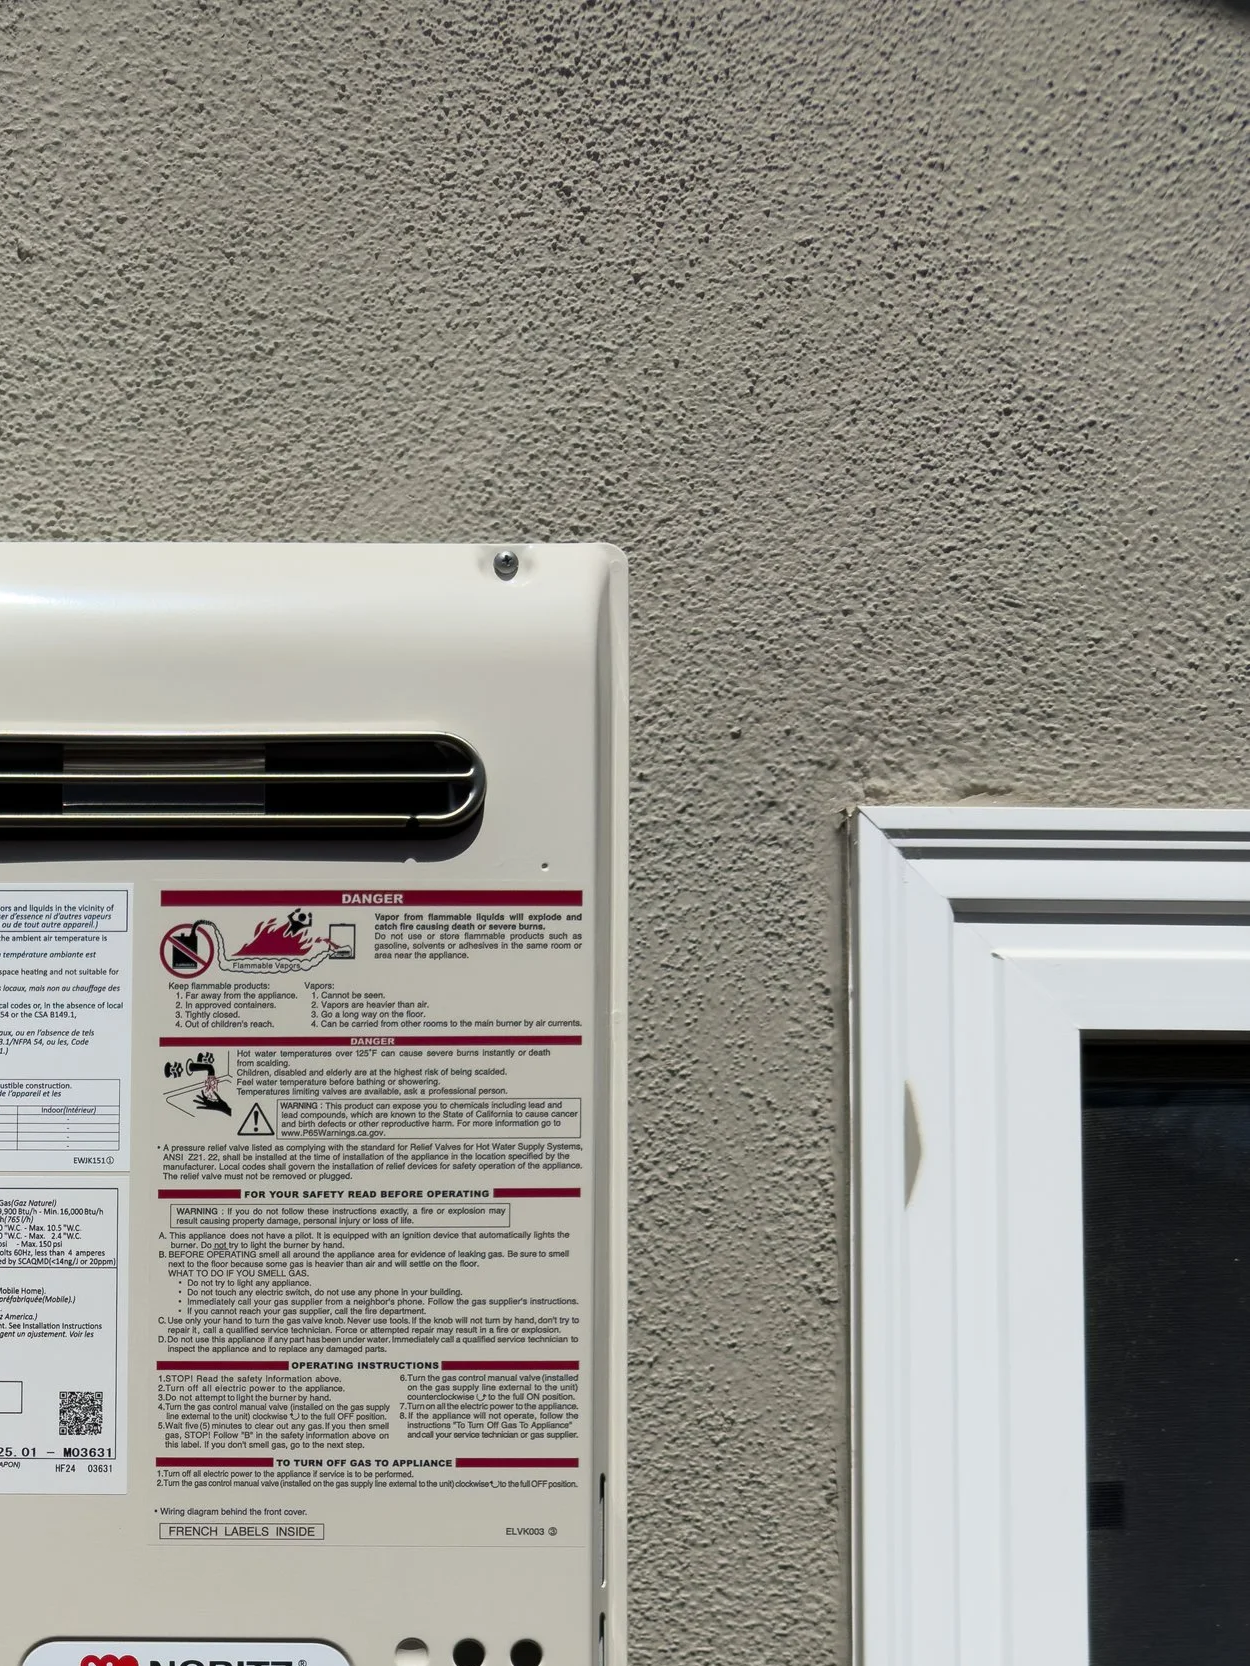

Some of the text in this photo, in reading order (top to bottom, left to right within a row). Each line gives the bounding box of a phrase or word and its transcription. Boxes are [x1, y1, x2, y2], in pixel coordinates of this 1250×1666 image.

[341, 893, 403, 903] DANGER
[374, 913, 399, 922] Vapor
[403, 912, 423, 920] from
[476, 912, 504, 922] liquids
[528, 913, 561, 922] explode
[168, 981, 269, 991] Keep flammable products:
[303, 981, 334, 991] Vapors:
[350, 1037, 394, 1045] DANGER
[236, 1078, 253, 1086] Feel
[255, 1078, 277, 1086] water
[279, 1078, 327, 1087] temperature
[329, 1077, 354, 1085] before
[356, 1077, 385, 1087] bathing
[397, 1076, 440, 1087] showering.
[39, 1106, 98, 1115] Indoor(Intérieur)
[280, 1128, 385, 1139] www.P65Warnings.ca.gov.
[244, 1190, 265, 1198] FOR
[269, 1190, 299, 1198] YOUR
[302, 1190, 344, 1198] SAFETY
[347, 1190, 376, 1198] READ
[380, 1190, 423, 1198] BEFORE
[167, 1269, 194, 1277] WHAT
[196, 1269, 208, 1277] TO
[210, 1269, 223, 1277] DO
[236, 1269, 255, 1277] YOU
[257, 1269, 286, 1277] SMELL
[288, 1268, 309, 1277] GAS.
[291, 1361, 438, 1369] OPERATING INSTRUCTIONS
[63, 1447, 115, 1457] M03631
[55, 1463, 112, 1472] HF24 03631
[392, 1459, 452, 1467] APPLIANCE
[168, 1526, 315, 1536] FRENCH LABELS INSIDE
[505, 1527, 544, 1535] ELVK003
